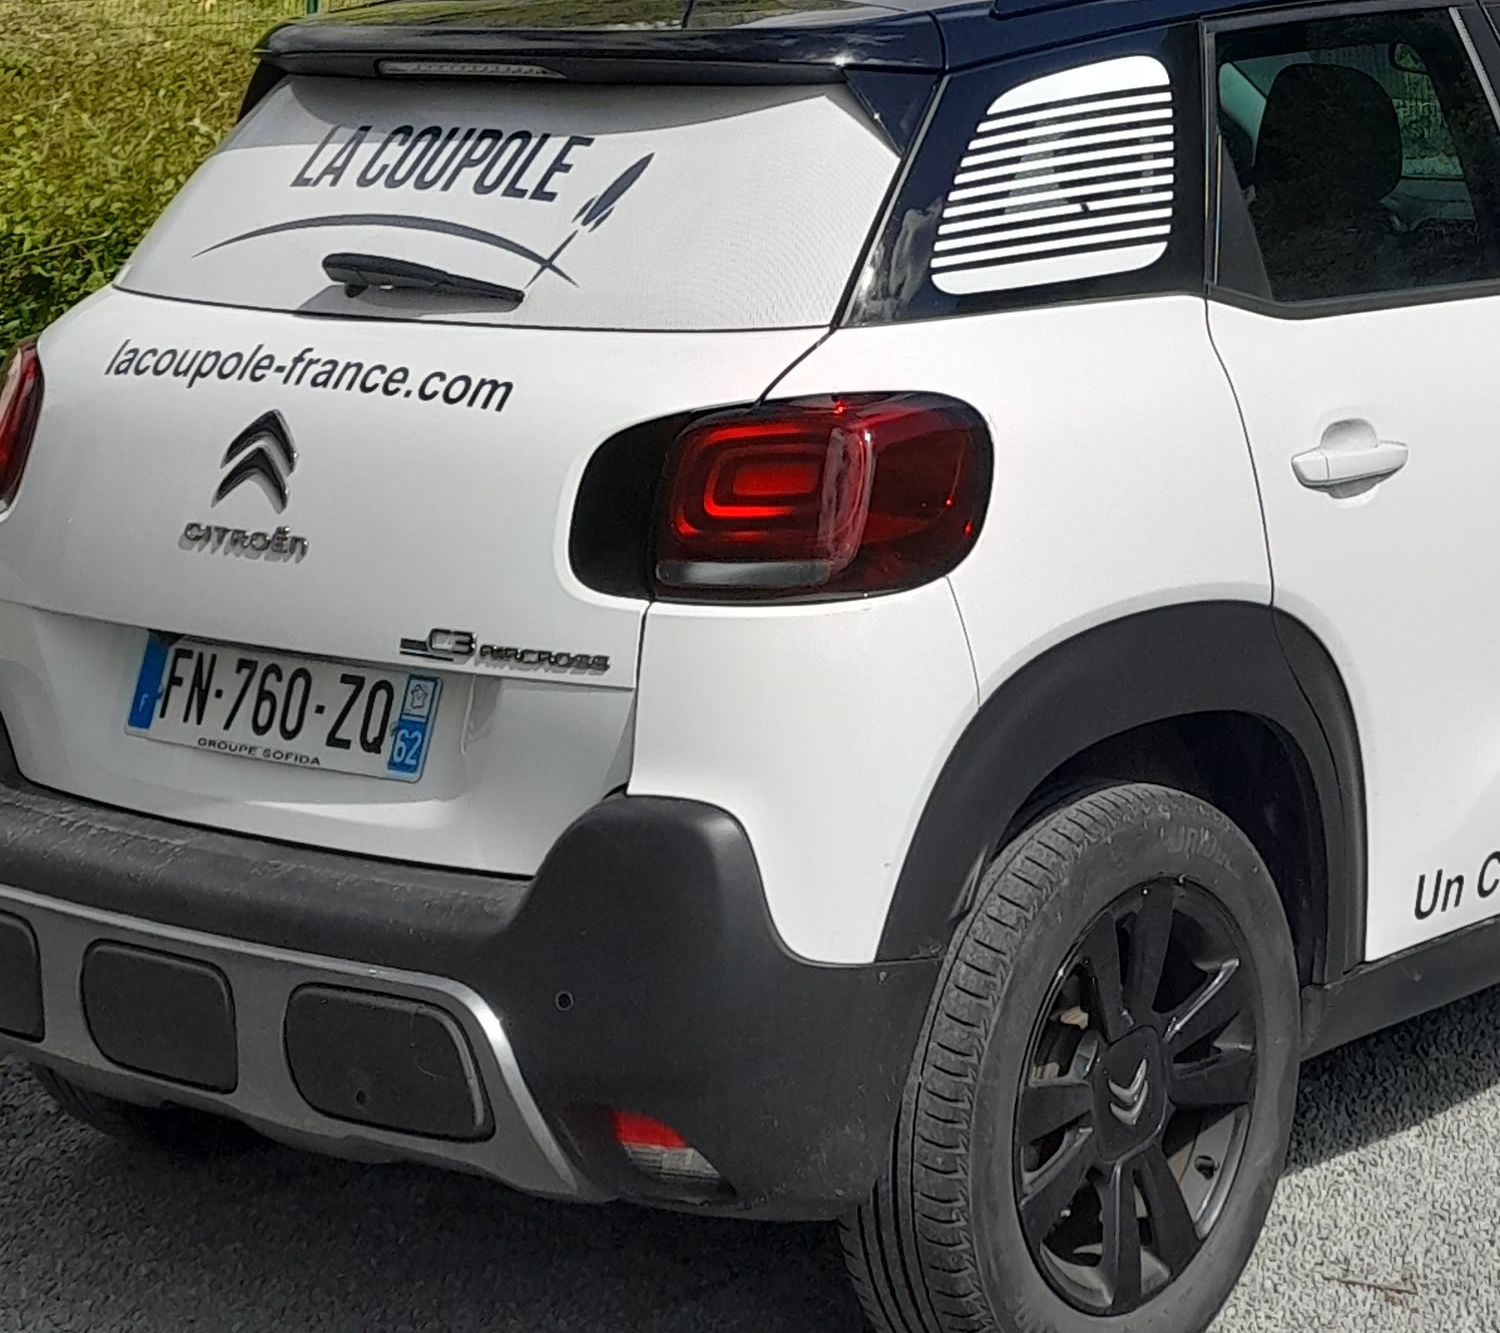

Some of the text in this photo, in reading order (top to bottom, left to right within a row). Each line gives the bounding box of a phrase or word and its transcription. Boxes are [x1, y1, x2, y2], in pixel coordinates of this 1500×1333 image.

[290, 125, 594, 202] LA COUPOLE
[104, 338, 514, 412] lacoupole-france.com
[197, 737, 321, 766] GROUPE SOFIDA
[392, 727, 423, 766] 62
[1413, 868, 1464, 921] Un
